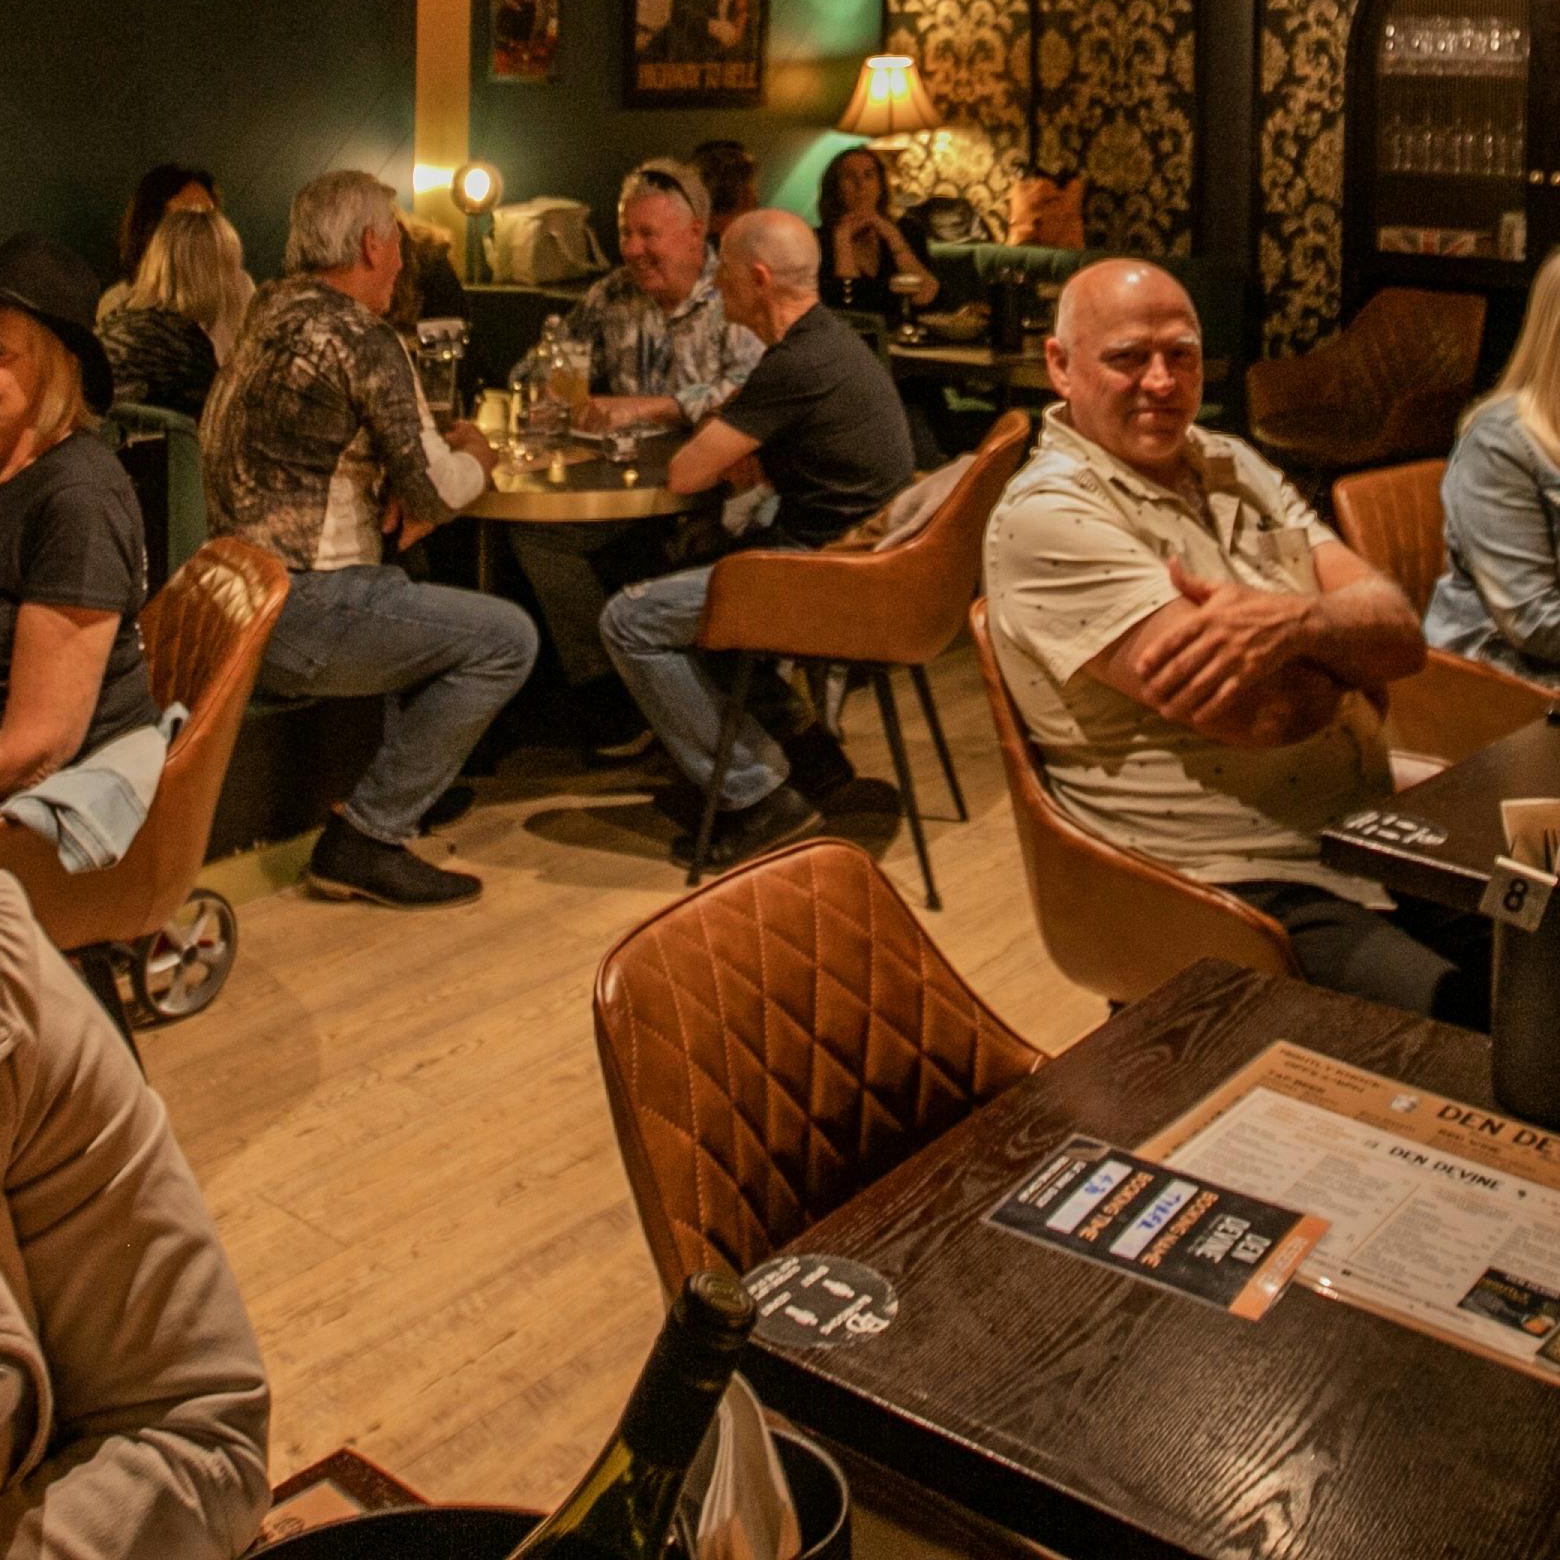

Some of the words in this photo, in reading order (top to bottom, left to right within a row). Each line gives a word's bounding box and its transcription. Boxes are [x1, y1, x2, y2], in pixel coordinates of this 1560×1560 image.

[1503, 878, 1529, 914] 8
[1437, 1103, 1508, 1136] DEN
[1389, 1145, 1429, 1167] DEN
[1433, 1160, 1501, 1191] DEVINE
[1103, 1171, 1156, 1217] BOOKING
[1079, 1213, 1115, 1242] TIME
[1170, 1190, 1220, 1237] BOOKING
[1141, 1233, 1181, 1269] NAME
[1194, 1214, 1252, 1264] DEVINE
[1230, 1232, 1273, 1265] DEN
